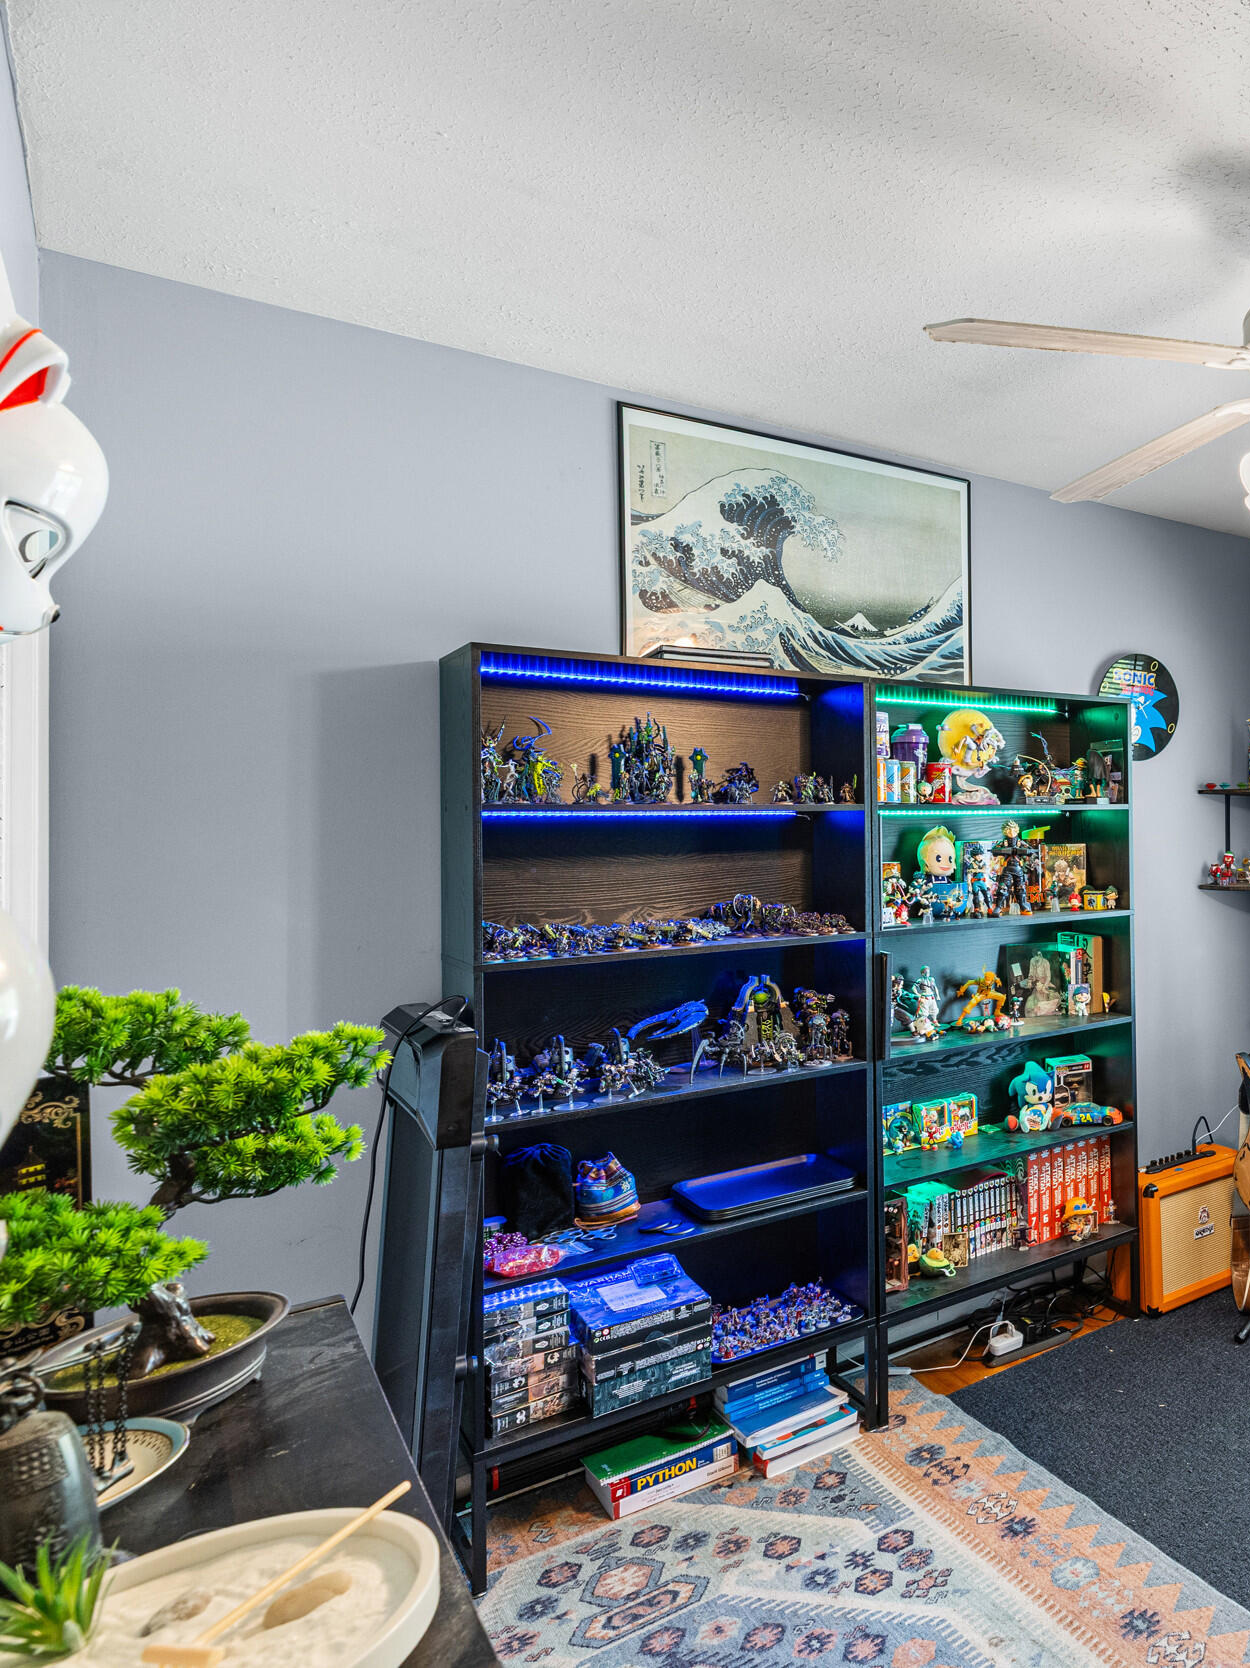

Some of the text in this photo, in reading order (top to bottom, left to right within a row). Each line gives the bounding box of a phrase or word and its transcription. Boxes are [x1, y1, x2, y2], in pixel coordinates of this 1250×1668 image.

[1113, 668, 1156, 687] SONIC
[1080, 1113, 1093, 1123] 24
[1056, 1209, 1060, 1218] 5
[1032, 1217, 1036, 1226] 7
[1043, 1214, 1048, 1223] 6
[637, 1458, 697, 1491] PYTHON
